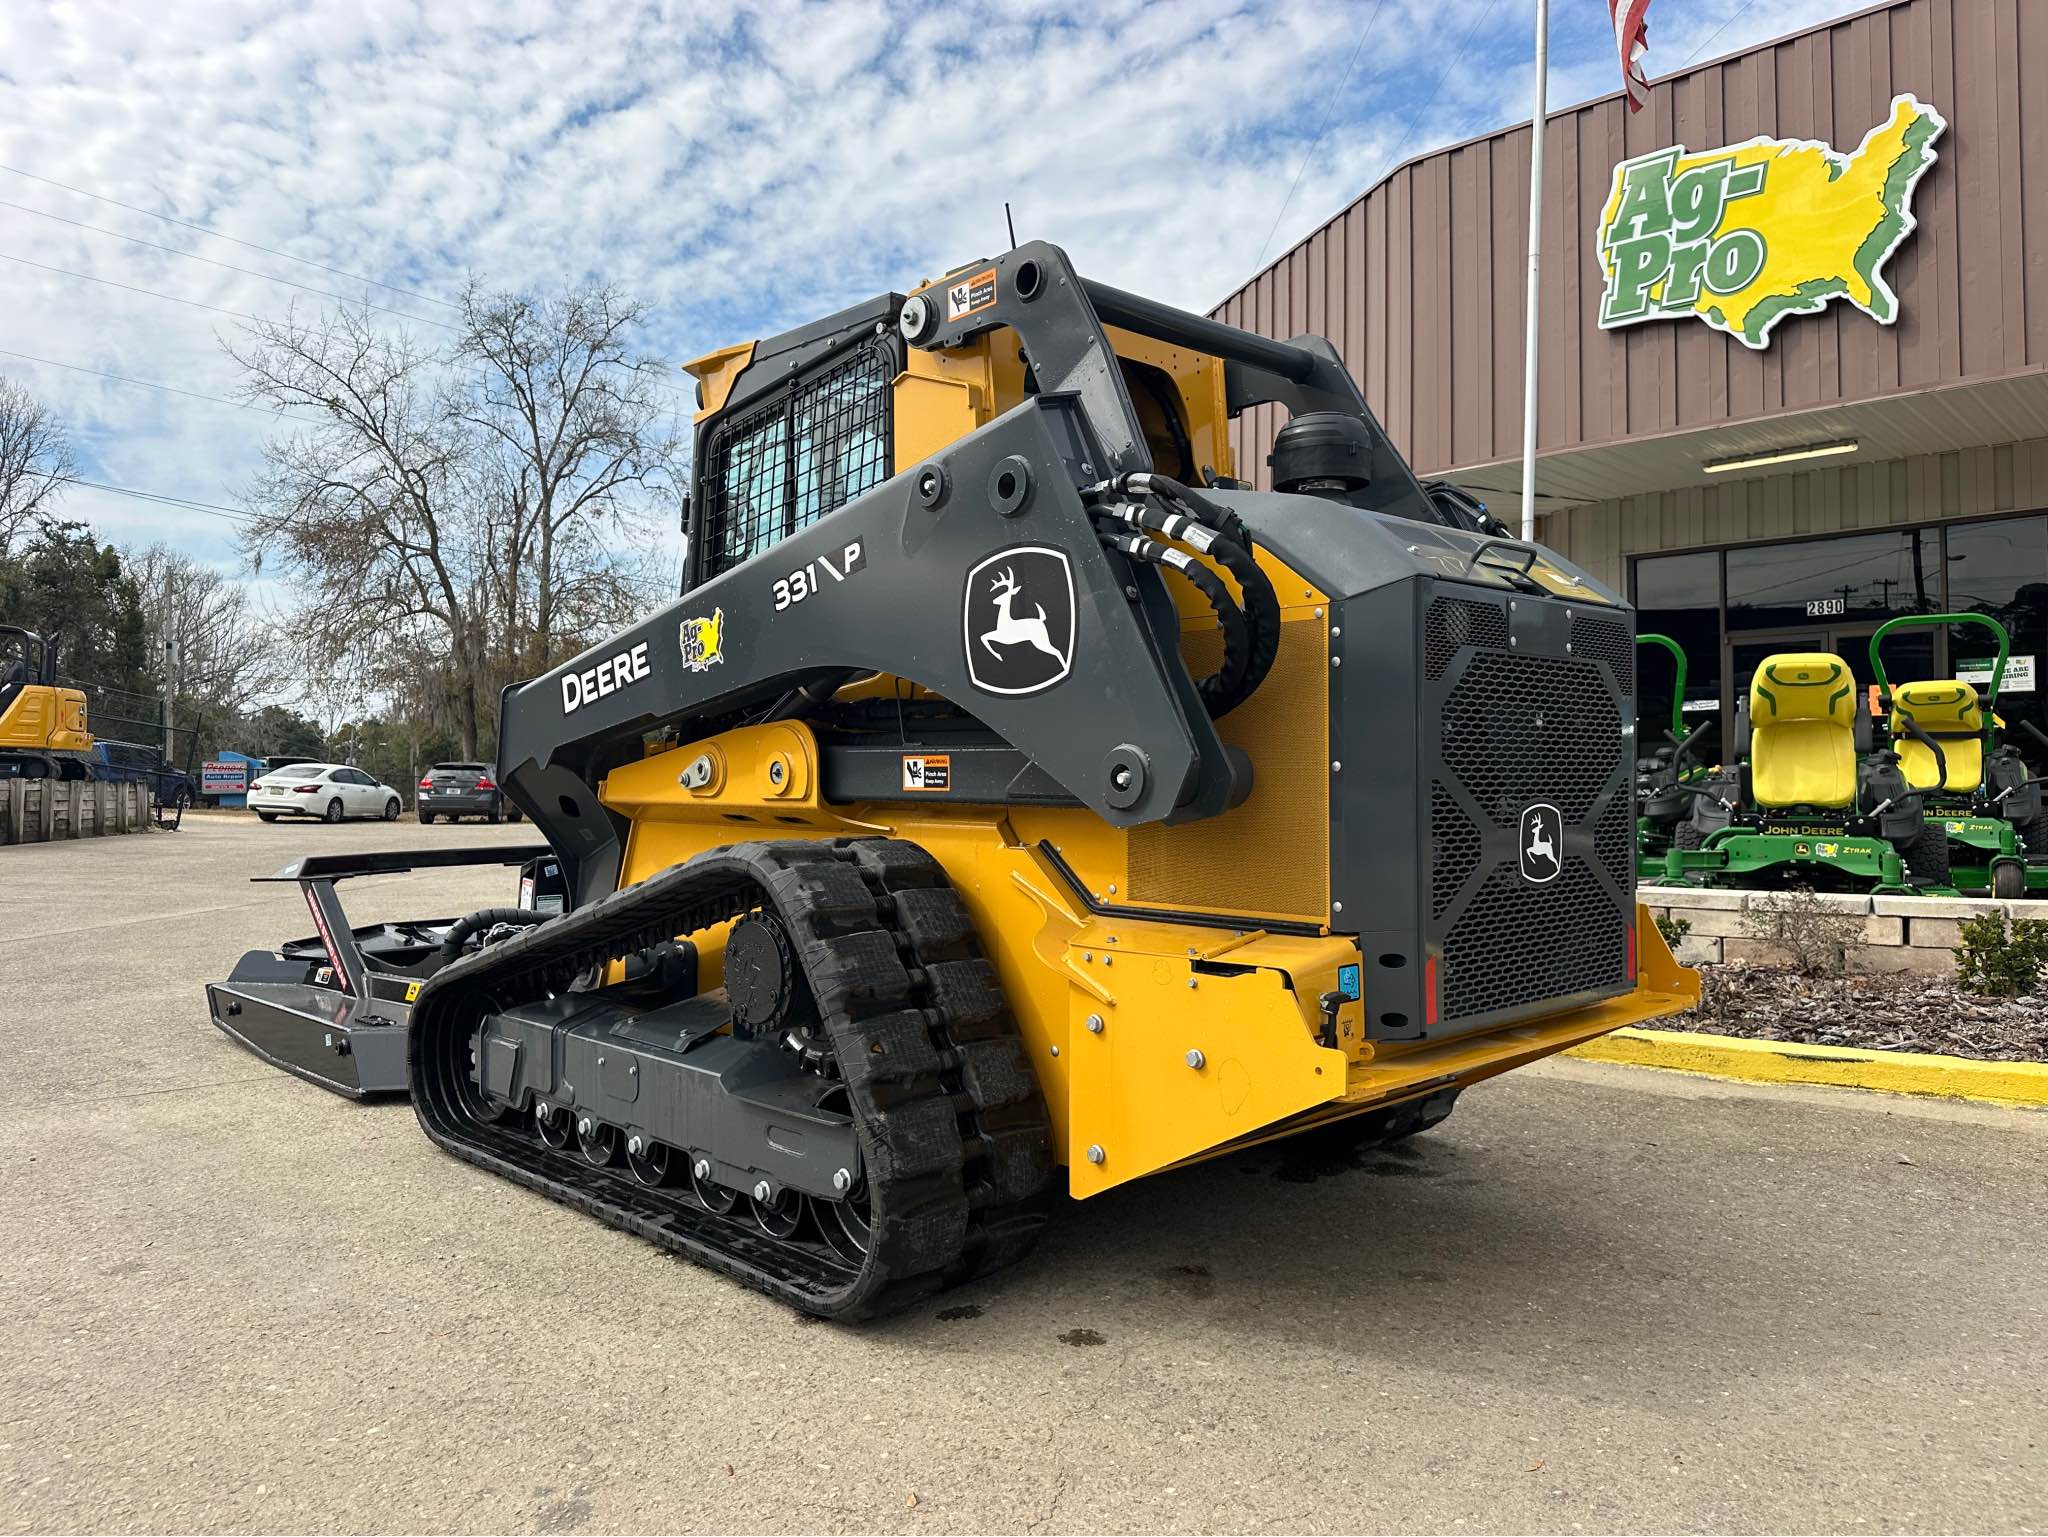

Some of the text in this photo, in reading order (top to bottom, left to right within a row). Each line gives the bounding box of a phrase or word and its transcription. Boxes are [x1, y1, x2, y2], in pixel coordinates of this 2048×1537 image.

[1605, 155, 1767, 246] Ag-
[1605, 231, 1767, 320] Pro
[1808, 600, 1843, 615] 2890
[682, 623, 702, 645] Ag-
[683, 641, 704, 663] Pro
[561, 641, 651, 714] DEERE
[2013, 665, 2029, 673] ARE
[1936, 809, 1973, 817] DEERE
[1764, 825, 1845, 836] JOHN DEERE
[1842, 846, 1872, 855] ZTRAK
